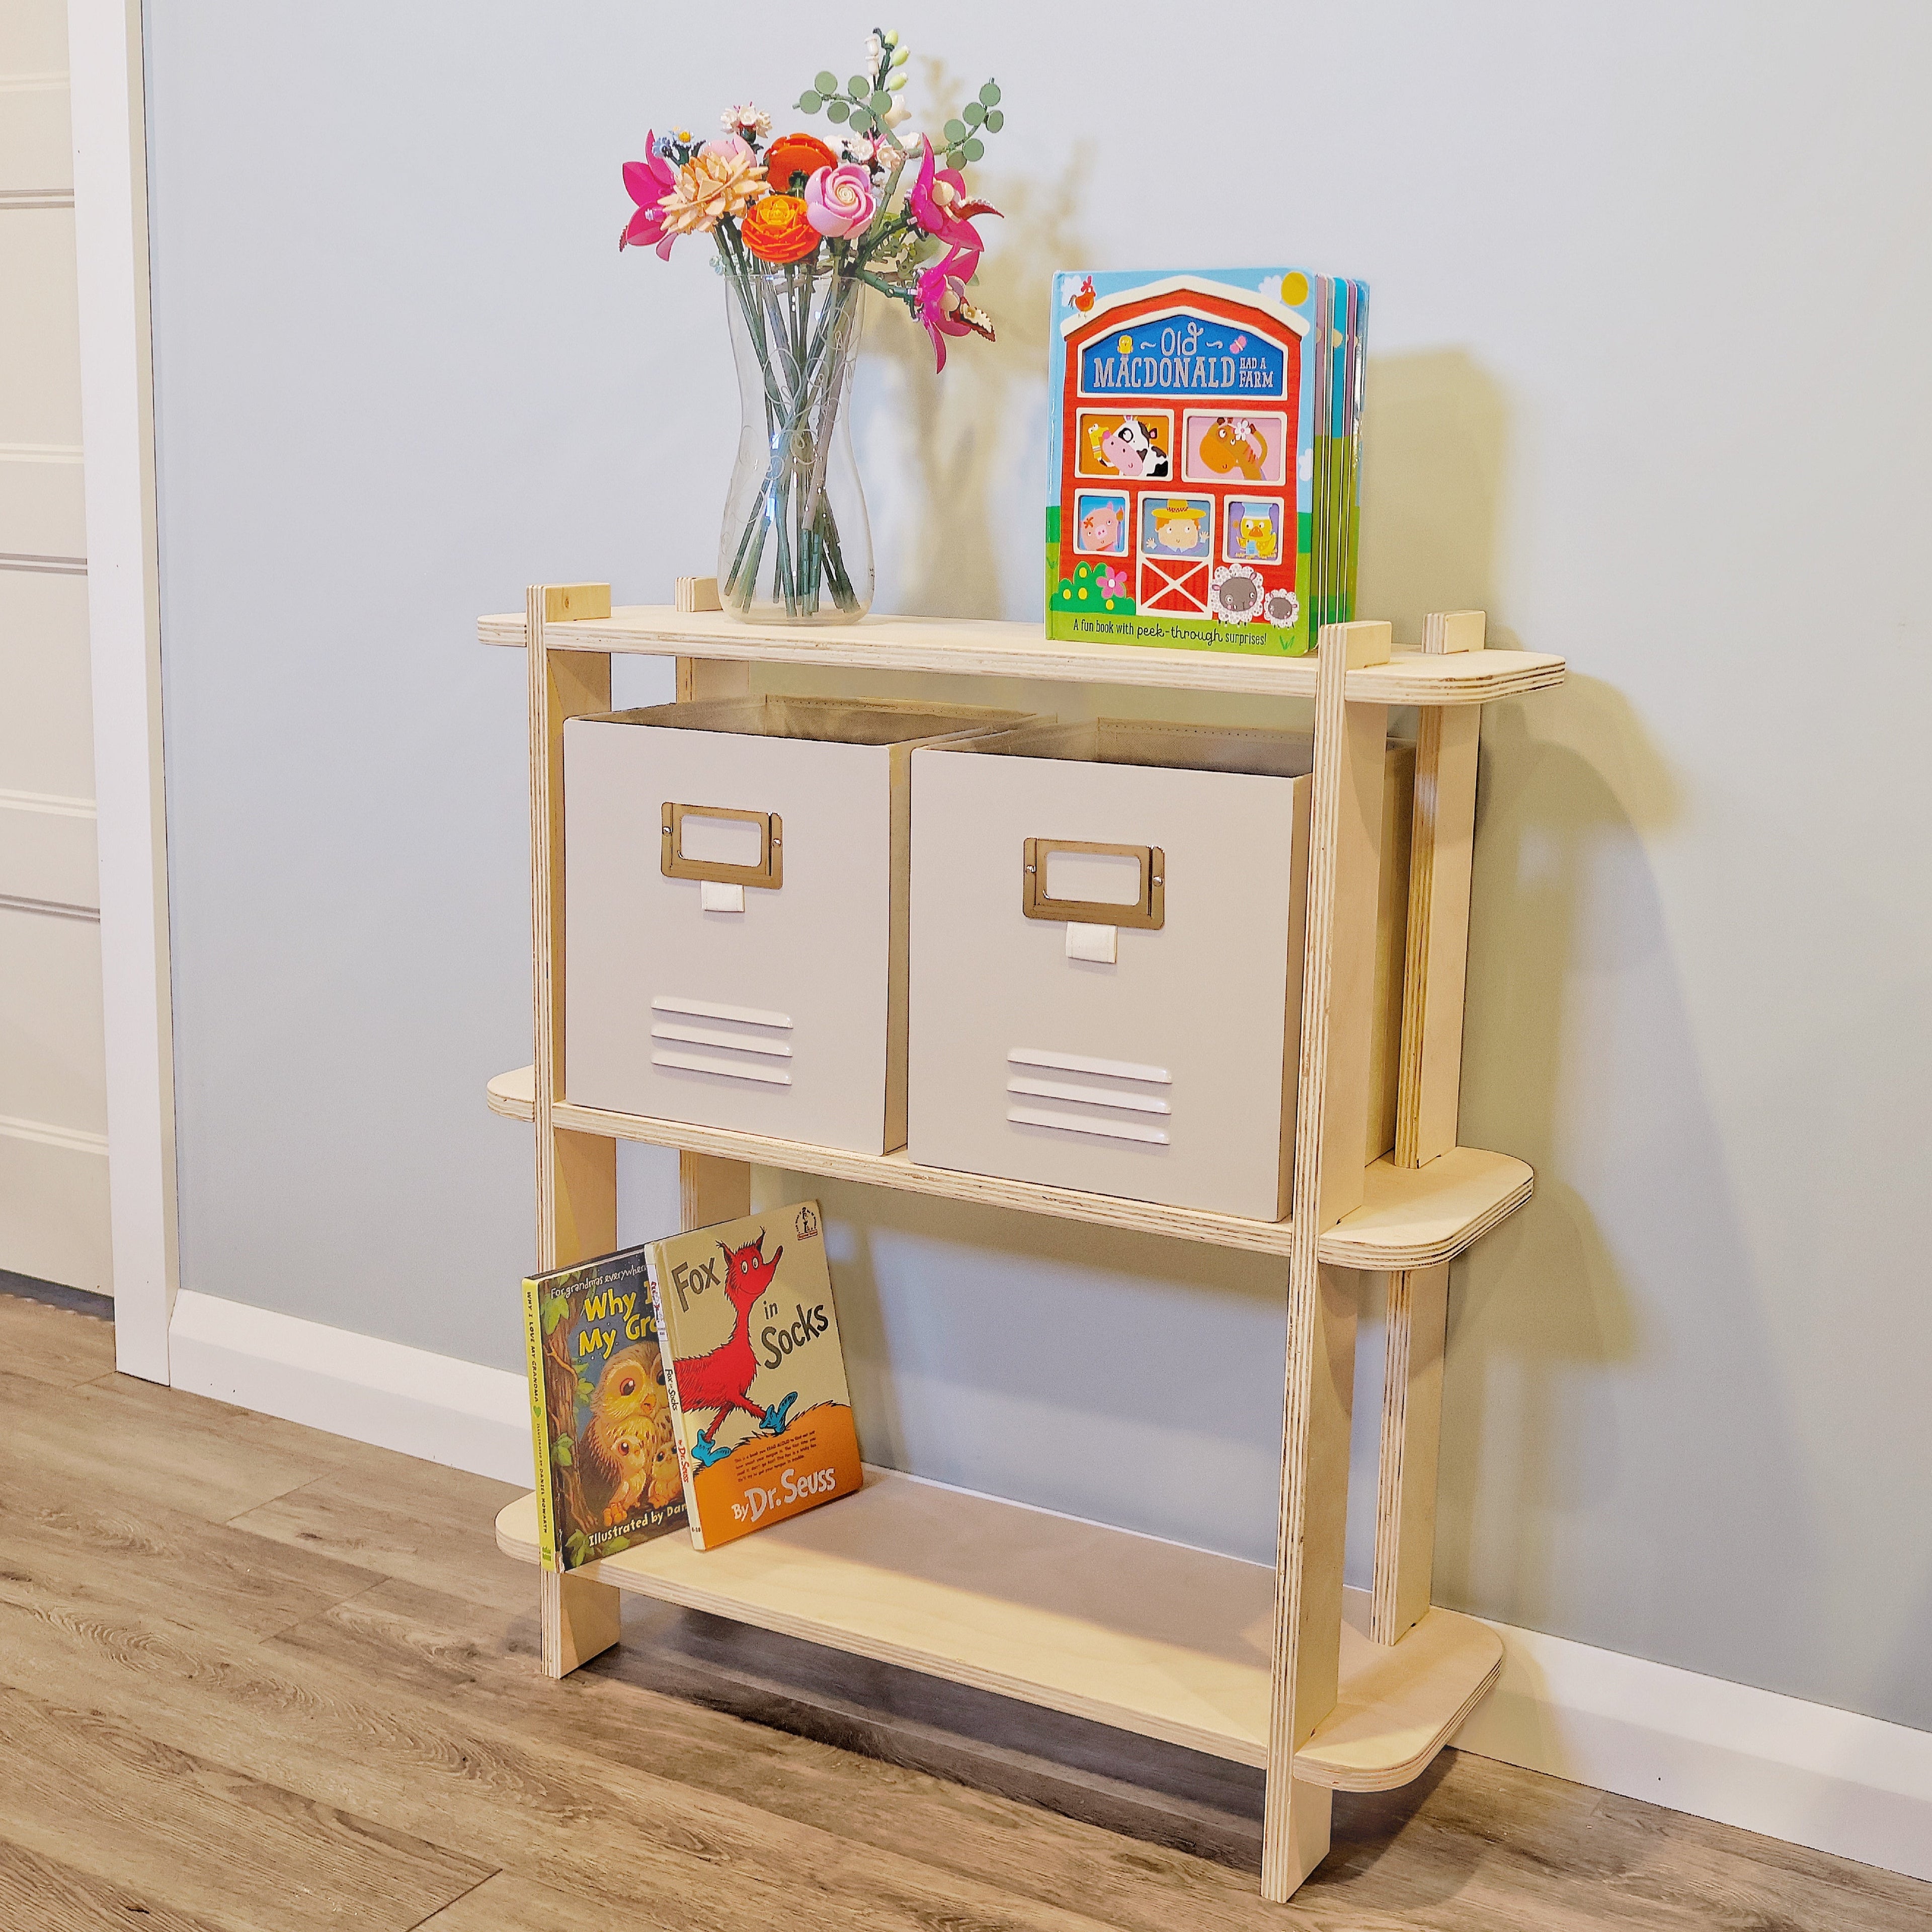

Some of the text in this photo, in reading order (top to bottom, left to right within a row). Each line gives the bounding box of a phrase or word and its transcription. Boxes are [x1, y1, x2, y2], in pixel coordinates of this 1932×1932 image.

[1161, 321, 1204, 356] Old
[1093, 356, 1235, 388] MACDONALD
[1240, 357, 1266, 369] HAD A
[1239, 371, 1273, 388] FARM
[1073, 618, 1267, 646] A fun book with peek-through surprises!
[551, 1287, 564, 1300] For
[566, 1275, 603, 1298] grandmas
[671, 1257, 721, 1313] Fox
[585, 1289, 636, 1322] Why
[763, 1300, 778, 1320] in
[580, 1328, 616, 1359] My
[761, 1304, 829, 1369] Socks
[530, 1346, 536, 1359] MY
[668, 1388, 679, 1411] Socks
[731, 1468, 836, 1522] By Dr. Seuss
[588, 1513, 648, 1547] Illustrated
[651, 1511, 663, 1525] by
